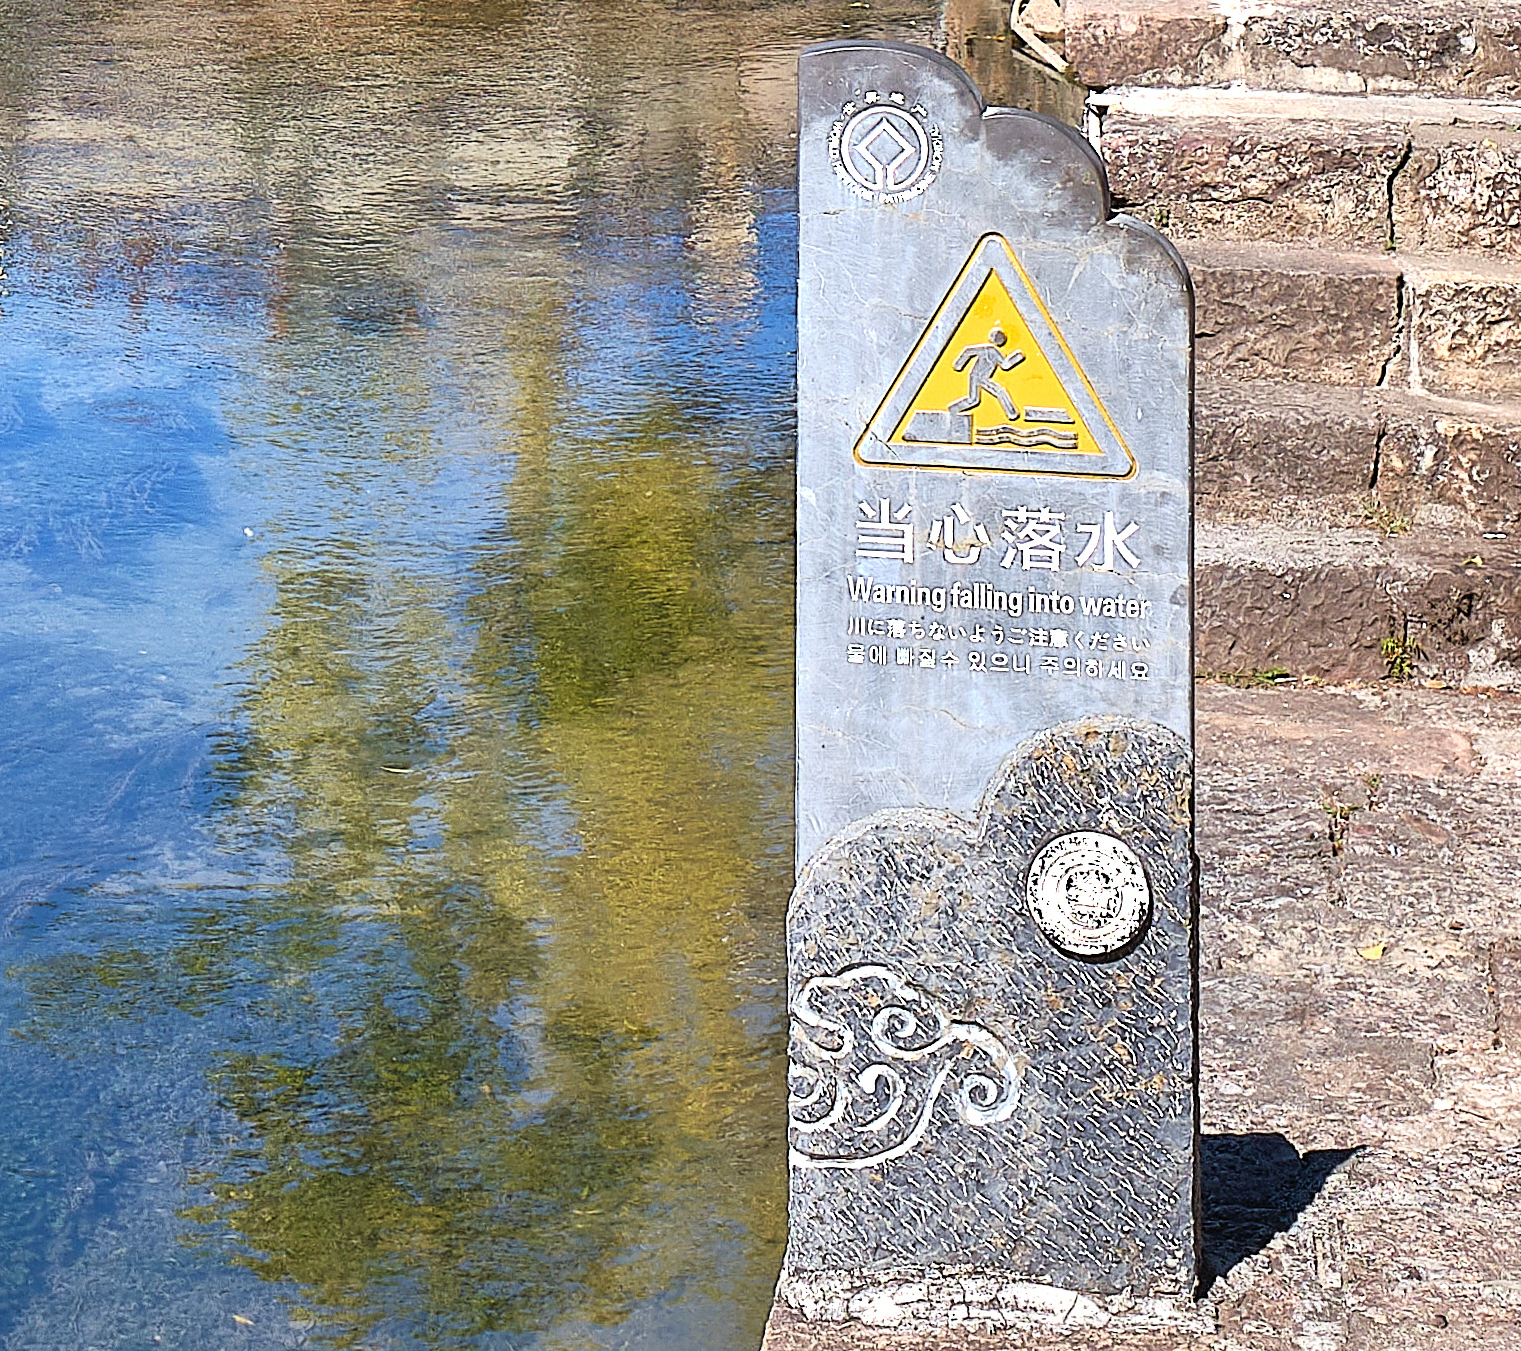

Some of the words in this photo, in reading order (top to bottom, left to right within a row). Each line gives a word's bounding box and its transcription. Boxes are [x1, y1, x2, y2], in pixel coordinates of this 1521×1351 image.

[855, 497, 1142, 572] 当心落水
[847, 575, 947, 613] Warning
[950, 581, 1023, 618] falling
[1028, 585, 1075, 616] into
[1080, 593, 1152, 620] water
[847, 617, 1152, 652] 川に落ちないようご注意ください
[967, 650, 1032, 675] 있으니
[1039, 655, 1151, 682] 주의하세요
